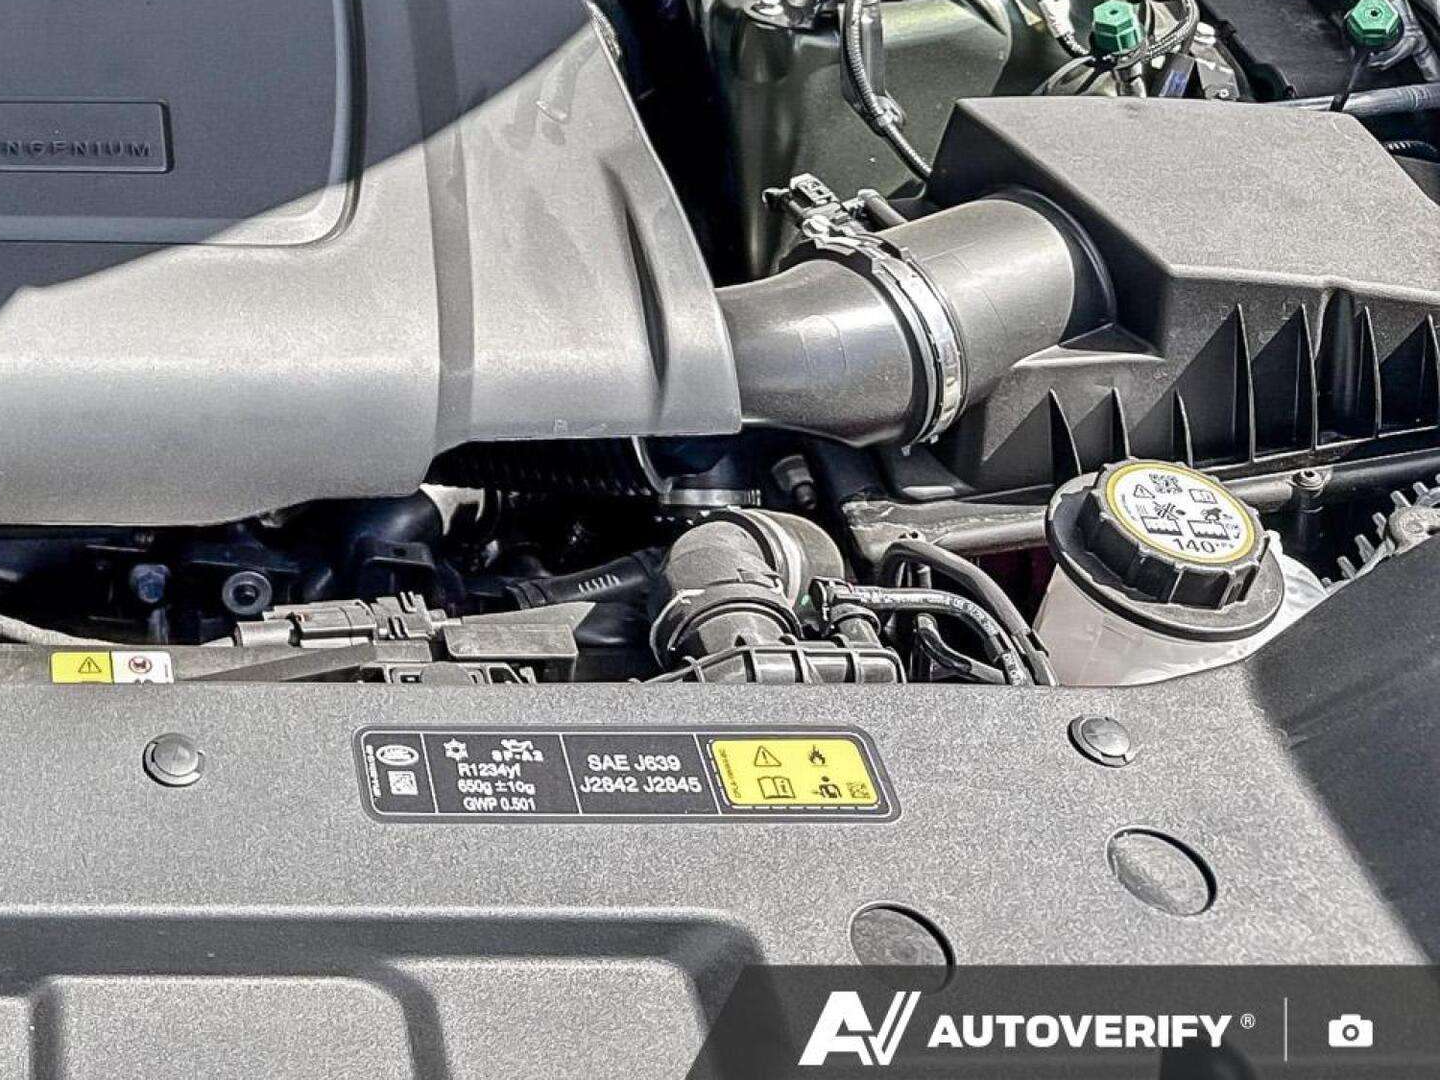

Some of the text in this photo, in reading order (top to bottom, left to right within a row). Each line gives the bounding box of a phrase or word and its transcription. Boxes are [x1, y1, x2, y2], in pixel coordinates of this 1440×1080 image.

[1173, 538, 1216, 554] 140
[458, 763, 521, 779] R1234yf
[587, 754, 682, 772] SAE J639
[580, 776, 702, 793] J2842 J2845
[463, 798, 536, 811] GWP 0.501
